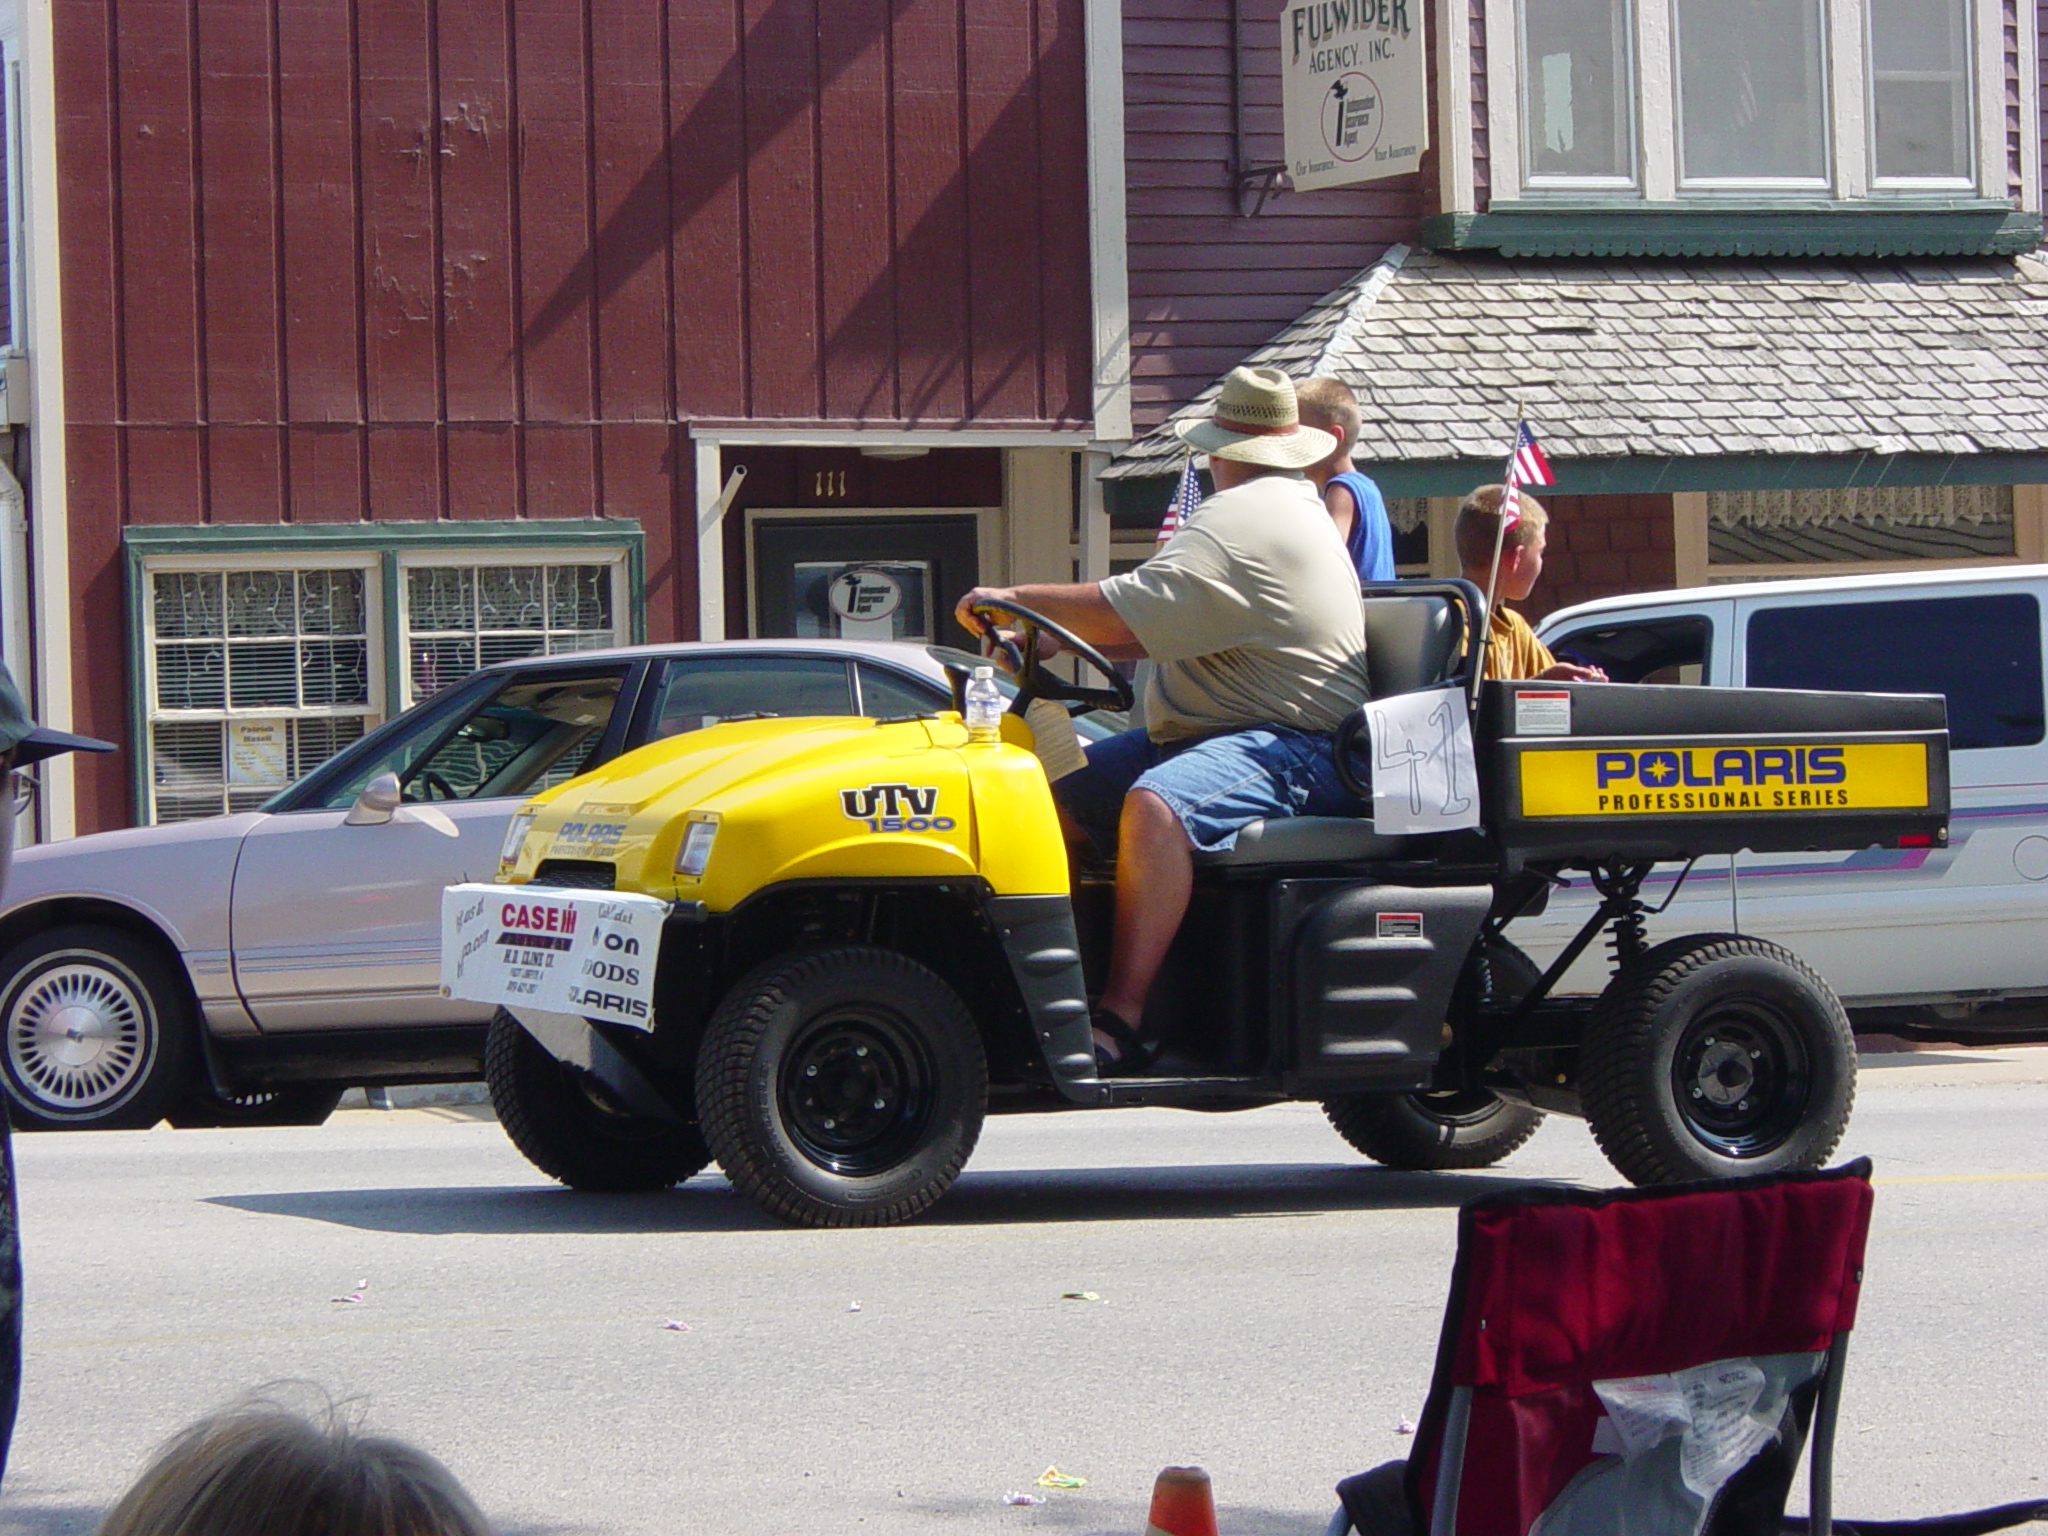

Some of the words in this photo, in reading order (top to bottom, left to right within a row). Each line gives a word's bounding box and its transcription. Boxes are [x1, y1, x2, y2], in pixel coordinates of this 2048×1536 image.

[1292, 0, 1411, 64] FULWIDER
[1369, 38, 1395, 62] INC.
[815, 470, 847, 497] 111
[1374, 701, 1472, 816] 41
[1597, 747, 1847, 789] POLARIS
[839, 782, 940, 820] UTV
[1599, 791, 1763, 811] PROFESSIONAL
[1773, 788, 1849, 807] SERIES
[556, 822, 627, 845] POLARIS
[865, 816, 956, 833] 1500
[501, 903, 559, 931] CASE
